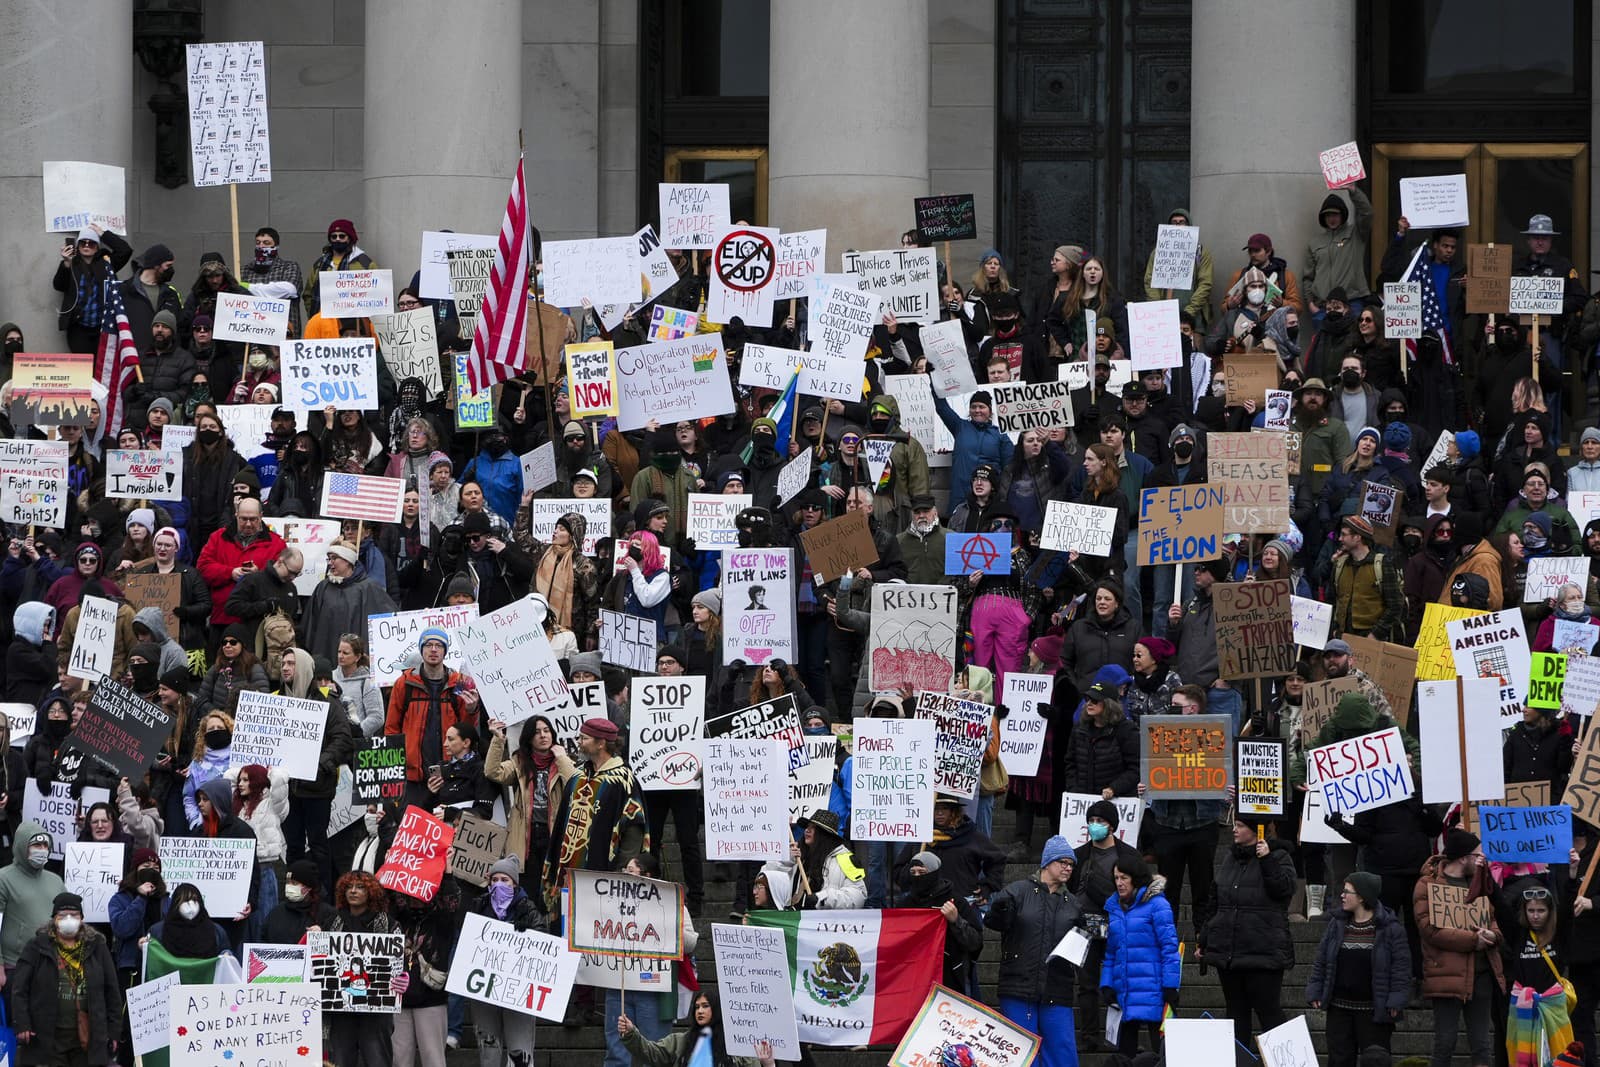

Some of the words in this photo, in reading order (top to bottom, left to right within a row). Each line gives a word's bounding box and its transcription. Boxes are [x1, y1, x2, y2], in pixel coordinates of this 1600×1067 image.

[669, 187, 711, 206] AMERICA
[681, 205, 689, 214] IS
[692, 203, 704, 213] AN
[668, 215, 714, 233] EMPIRE
[722, 240, 771, 261] ELON
[1159, 241, 1171, 249] WE
[1174, 241, 1192, 250] BUILT
[846, 255, 890, 276] Injustice
[894, 252, 930, 270] Thrives
[722, 263, 765, 284] COUP
[224, 299, 248, 310] WHO
[254, 301, 285, 313] VOTED
[833, 289, 870, 308] FASCISM
[1396, 295, 1409, 303] NO
[653, 307, 698, 328] DUMP
[827, 303, 871, 322] REQUIRES
[386, 313, 413, 332] FUCK
[819, 313, 872, 337] COMPLIANCE
[1386, 317, 1417, 327] STOLEN
[823, 328, 850, 344] HOLD
[391, 346, 415, 362] FUCK
[617, 345, 689, 376] Colonization
[290, 365, 310, 378] TO
[321, 364, 360, 377] YOUR
[754, 362, 772, 373] OK
[766, 374, 780, 386] TO
[810, 379, 852, 394] NAZIS
[301, 382, 366, 405] SOUL
[575, 380, 611, 407] NOW
[993, 381, 1071, 404] DEMOCRACY
[458, 401, 491, 423] COUP
[1016, 401, 1046, 410] OVER
[1215, 437, 1282, 457] NATO
[144, 465, 161, 473] NOT
[1211, 462, 1283, 480] PLEASE
[112, 472, 174, 494] Invisible!
[19, 493, 56, 504] LGBTQ+
[535, 503, 586, 513] INTERNMENT
[589, 504, 608, 513] WAS
[692, 502, 721, 515] HATE
[1073, 505, 1087, 515] SO
[1091, 507, 1107, 518] BAD
[692, 518, 713, 529] NOT
[1053, 515, 1079, 526] EVEN
[1086, 518, 1102, 528] THE
[693, 532, 707, 544] US
[1046, 524, 1112, 545] INTROVERTS
[1142, 527, 1167, 542] THE
[1079, 543, 1096, 553] OUT
[1150, 534, 1216, 563] FELON
[731, 554, 760, 568] KEEP
[763, 554, 787, 567] YOUR
[761, 570, 787, 579] LAWS
[1544, 575, 1568, 585] YOUR
[883, 590, 956, 613] RESIST
[1235, 582, 1288, 609] STOP
[379, 620, 406, 641] Only
[410, 619, 417, 632] A
[602, 610, 654, 644] FREE
[740, 614, 775, 635] OFF
[1462, 613, 1501, 630] MAKE
[83, 623, 106, 648] FOR
[458, 626, 486, 645] My
[505, 625, 543, 650] Criminal
[728, 637, 739, 647] MY
[1455, 627, 1520, 650] AMERICA
[525, 678, 570, 708] FELON
[642, 683, 691, 706] STOP
[1011, 679, 1047, 693] TRUMP
[96, 686, 109, 700] NO
[111, 696, 121, 707] TE
[121, 702, 144, 722] NUBLE
[144, 716, 155, 728] LA
[102, 676, 119, 691] QUE
[120, 686, 129, 698] EL
[130, 693, 169, 724] PRIVILEGIO
[241, 693, 285, 707] PRIVILEGE
[287, 700, 295, 708] IS
[296, 701, 323, 712] WHEN
[1022, 700, 1031, 711] IS
[239, 705, 256, 713] YOU
[258, 707, 286, 717] THINK
[650, 712, 672, 724] THE
[236, 714, 288, 727] SOMETHING
[291, 720, 299, 728] IS
[301, 723, 320, 732] NOT
[883, 720, 904, 734] THE
[233, 734, 250, 743] YOU
[243, 724, 282, 736] PROBLEM
[283, 729, 320, 741] BECAUSE
[1148, 726, 1225, 754] YEETO
[232, 744, 274, 755] AFFECTED
[859, 737, 894, 751] POWER
[910, 741, 921, 752] OF
[1242, 743, 1278, 757] INJUSTICE
[358, 748, 405, 768] SPEAKING
[858, 757, 872, 769] THE
[880, 757, 912, 770] PEOPLE
[920, 759, 927, 768] IS
[1173, 749, 1205, 766] THE
[1242, 757, 1278, 767] ANYWHERE
[1315, 732, 1394, 782] RESIST
[356, 768, 374, 783] FOR
[377, 767, 405, 781] THOSE
[740, 763, 762, 771] about
[856, 775, 927, 790] STRONGER
[1150, 766, 1227, 790] CHEETO
[1241, 777, 1278, 793] JUSTICE
[359, 785, 379, 798] WHO
[1324, 763, 1408, 814] FASCISM
[870, 794, 893, 805] THAN
[896, 793, 914, 805] THE
[731, 804, 745, 814] did
[751, 806, 767, 817] you
[856, 810, 887, 821] PEOPLE
[905, 809, 920, 818] IN
[869, 822, 917, 836] POWER!
[1486, 810, 1514, 831] DEI
[1524, 810, 1567, 828] HURTS
[425, 820, 441, 839] TO
[161, 839, 168, 848] IF
[170, 839, 190, 848] YOU
[193, 839, 209, 848] ARE
[212, 838, 254, 849] NEUTRAL
[1489, 842, 1509, 853] NO
[70, 845, 112, 865] WE
[171, 849, 223, 859] SITUATIONS
[225, 851, 236, 859] OF
[196, 871, 214, 880] THE
[217, 872, 236, 880] SIDE
[595, 878, 661, 900] CHINGA
[1432, 903, 1490, 929] FACISM
[594, 919, 661, 942] MAGA
[329, 934, 353, 955] NO
[479, 922, 560, 957] Immigrants
[472, 946, 508, 967] MAKE
[512, 953, 558, 985] AMERICA
[466, 969, 552, 1012] GREAT
[188, 995, 208, 1014] AS
[220, 992, 227, 1007] A
[196, 1018, 221, 1032] ONE
[227, 1017, 246, 1029] DAY
[263, 1013, 290, 1025] HAVE
[730, 1016, 758, 1028] Women
[801, 1015, 865, 1030] MEXICO
[188, 1040, 203, 1052] AS
[214, 1036, 248, 1049] MANY
[257, 1030, 302, 1046] RIGHTS
